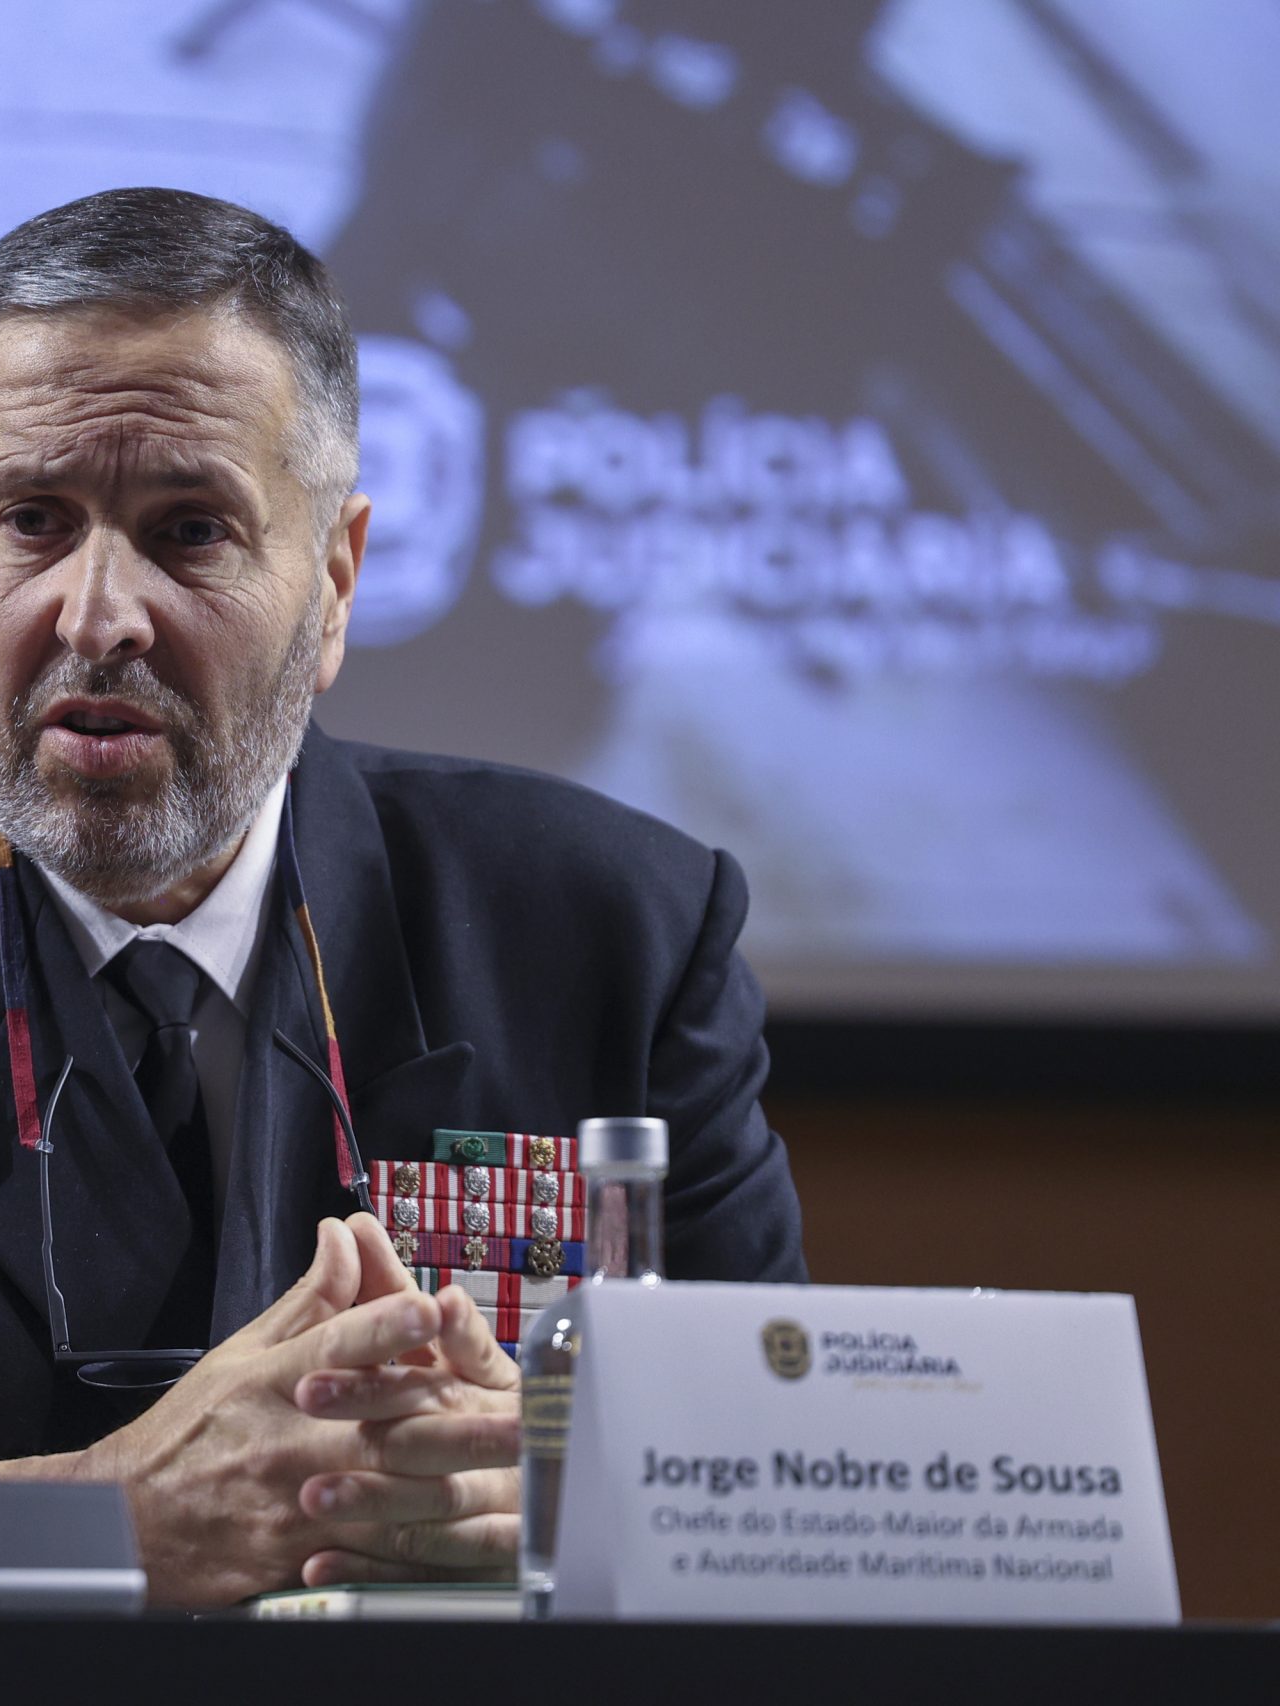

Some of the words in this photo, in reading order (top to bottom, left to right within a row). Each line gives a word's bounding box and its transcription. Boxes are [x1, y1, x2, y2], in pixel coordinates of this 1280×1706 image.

[642, 1448, 759, 1497] Jorge
[773, 1450, 910, 1491] Nobre
[925, 1451, 979, 1492] de
[991, 1455, 1122, 1495] Sousa
[651, 1506, 731, 1534] Chefe
[738, 1508, 776, 1535] do
[782, 1508, 964, 1538] Estado-Maior
[974, 1511, 1008, 1538] da
[1015, 1513, 1123, 1541] Armada
[673, 1553, 691, 1574] e
[696, 1550, 852, 1576] Autoridade
[993, 1553, 1113, 1581] Nacional
